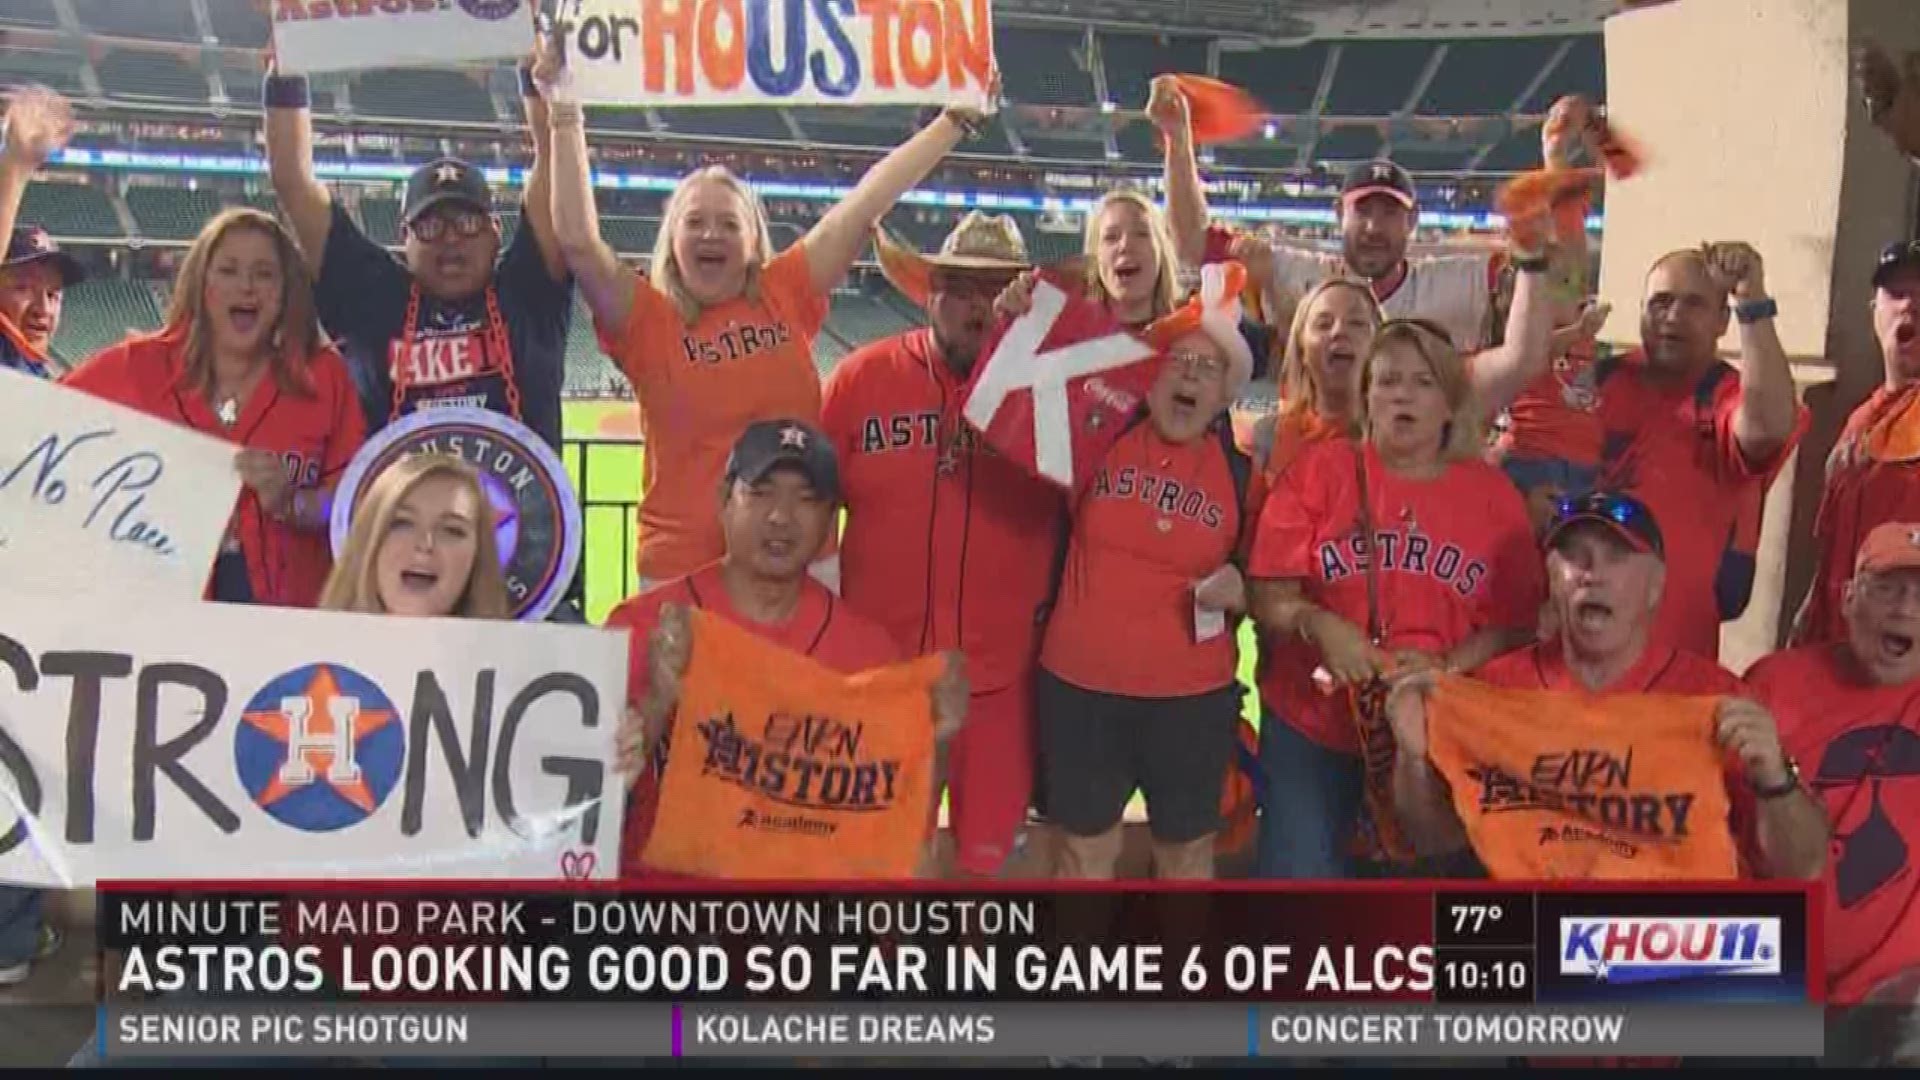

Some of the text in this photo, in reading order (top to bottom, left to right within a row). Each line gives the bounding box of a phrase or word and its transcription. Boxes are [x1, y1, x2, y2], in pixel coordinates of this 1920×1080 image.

[640, 0, 991, 98] HOUSTON
[962, 278, 1153, 488] K
[1, 430, 117, 505] No
[1093, 465, 1226, 531] ASTROS
[1318, 530, 1487, 596] ASTROS
